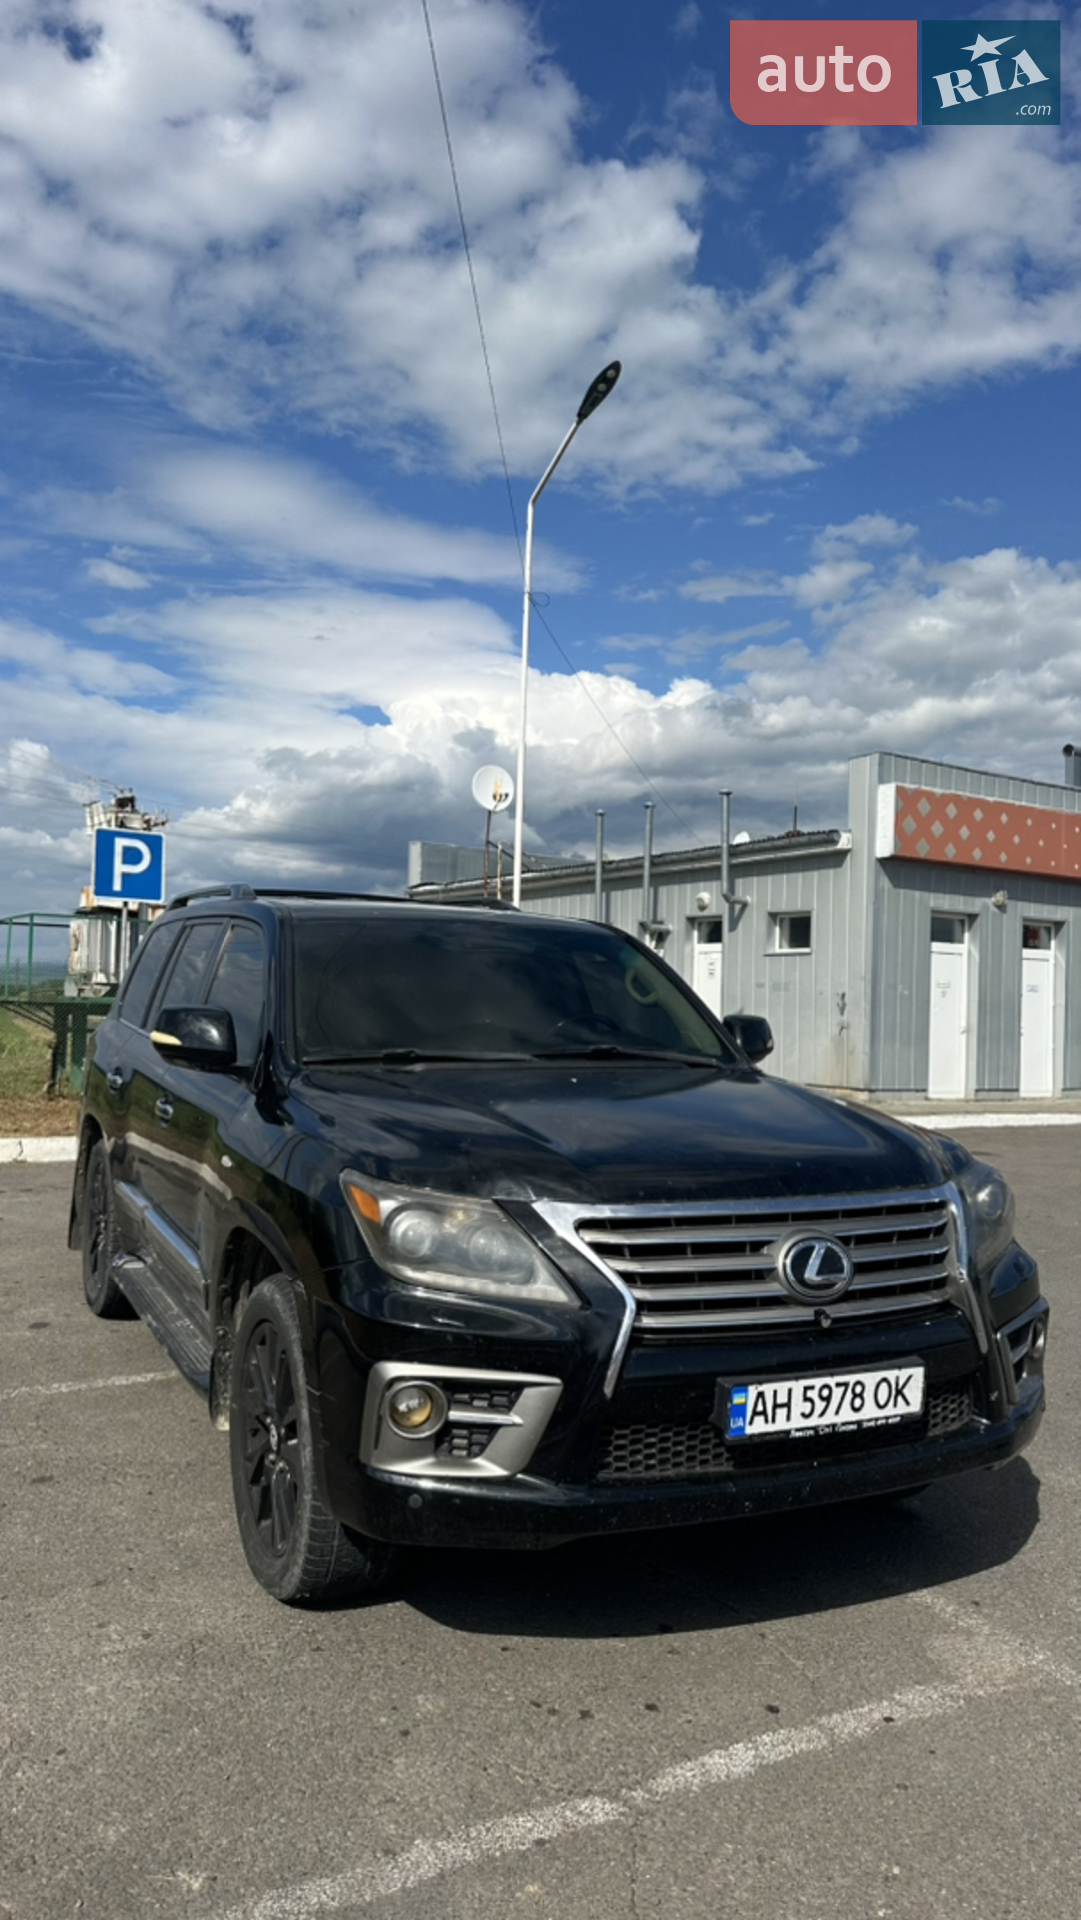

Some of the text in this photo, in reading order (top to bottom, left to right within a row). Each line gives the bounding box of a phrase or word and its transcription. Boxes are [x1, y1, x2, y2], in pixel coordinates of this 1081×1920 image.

[113, 837, 151, 892] P
[730, 1417, 744, 1429] UA
[749, 1374, 913, 1426] AH 5978 OK
